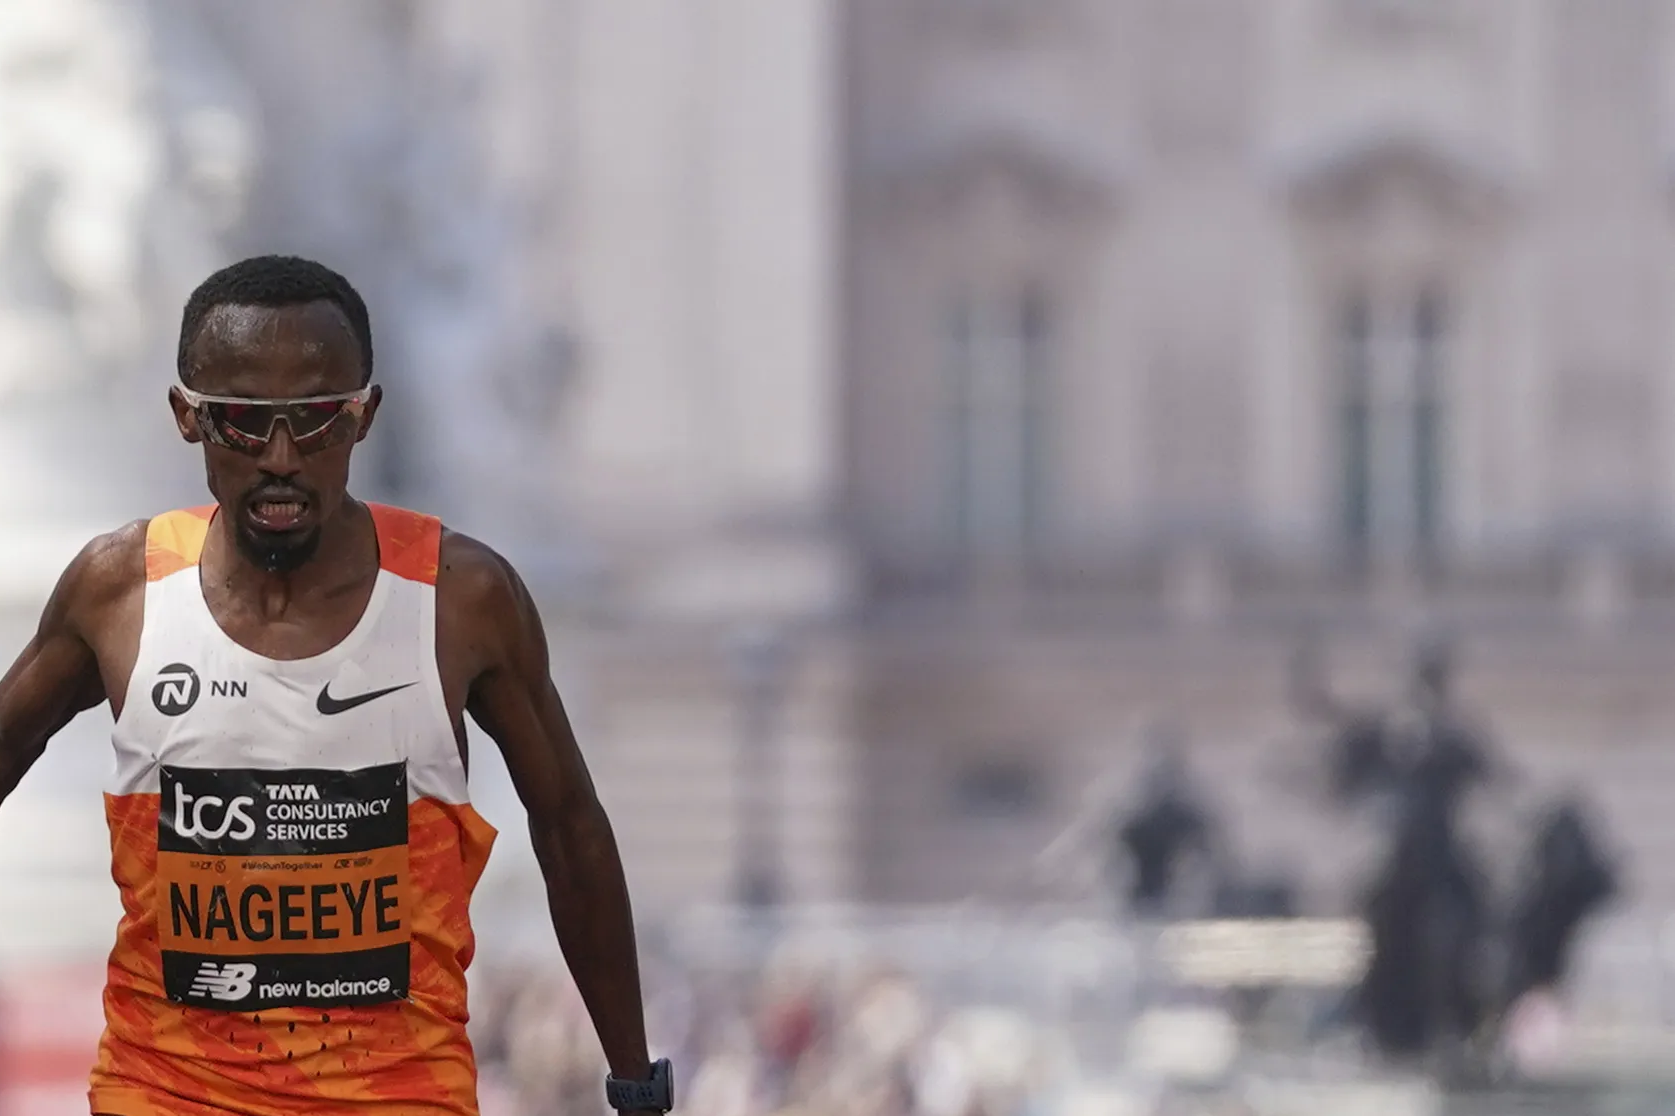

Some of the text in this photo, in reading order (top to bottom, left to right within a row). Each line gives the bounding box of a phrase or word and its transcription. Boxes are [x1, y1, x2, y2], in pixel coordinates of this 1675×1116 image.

[211, 680, 247, 698] NN
[265, 784, 320, 800] TATA
[174, 782, 256, 840] tcs
[266, 798, 391, 820] CONSULTANCY
[266, 823, 348, 841] SERVICES
[169, 874, 401, 942] NAGEEYE
[259, 981, 302, 999] new
[306, 977, 391, 998] balance
